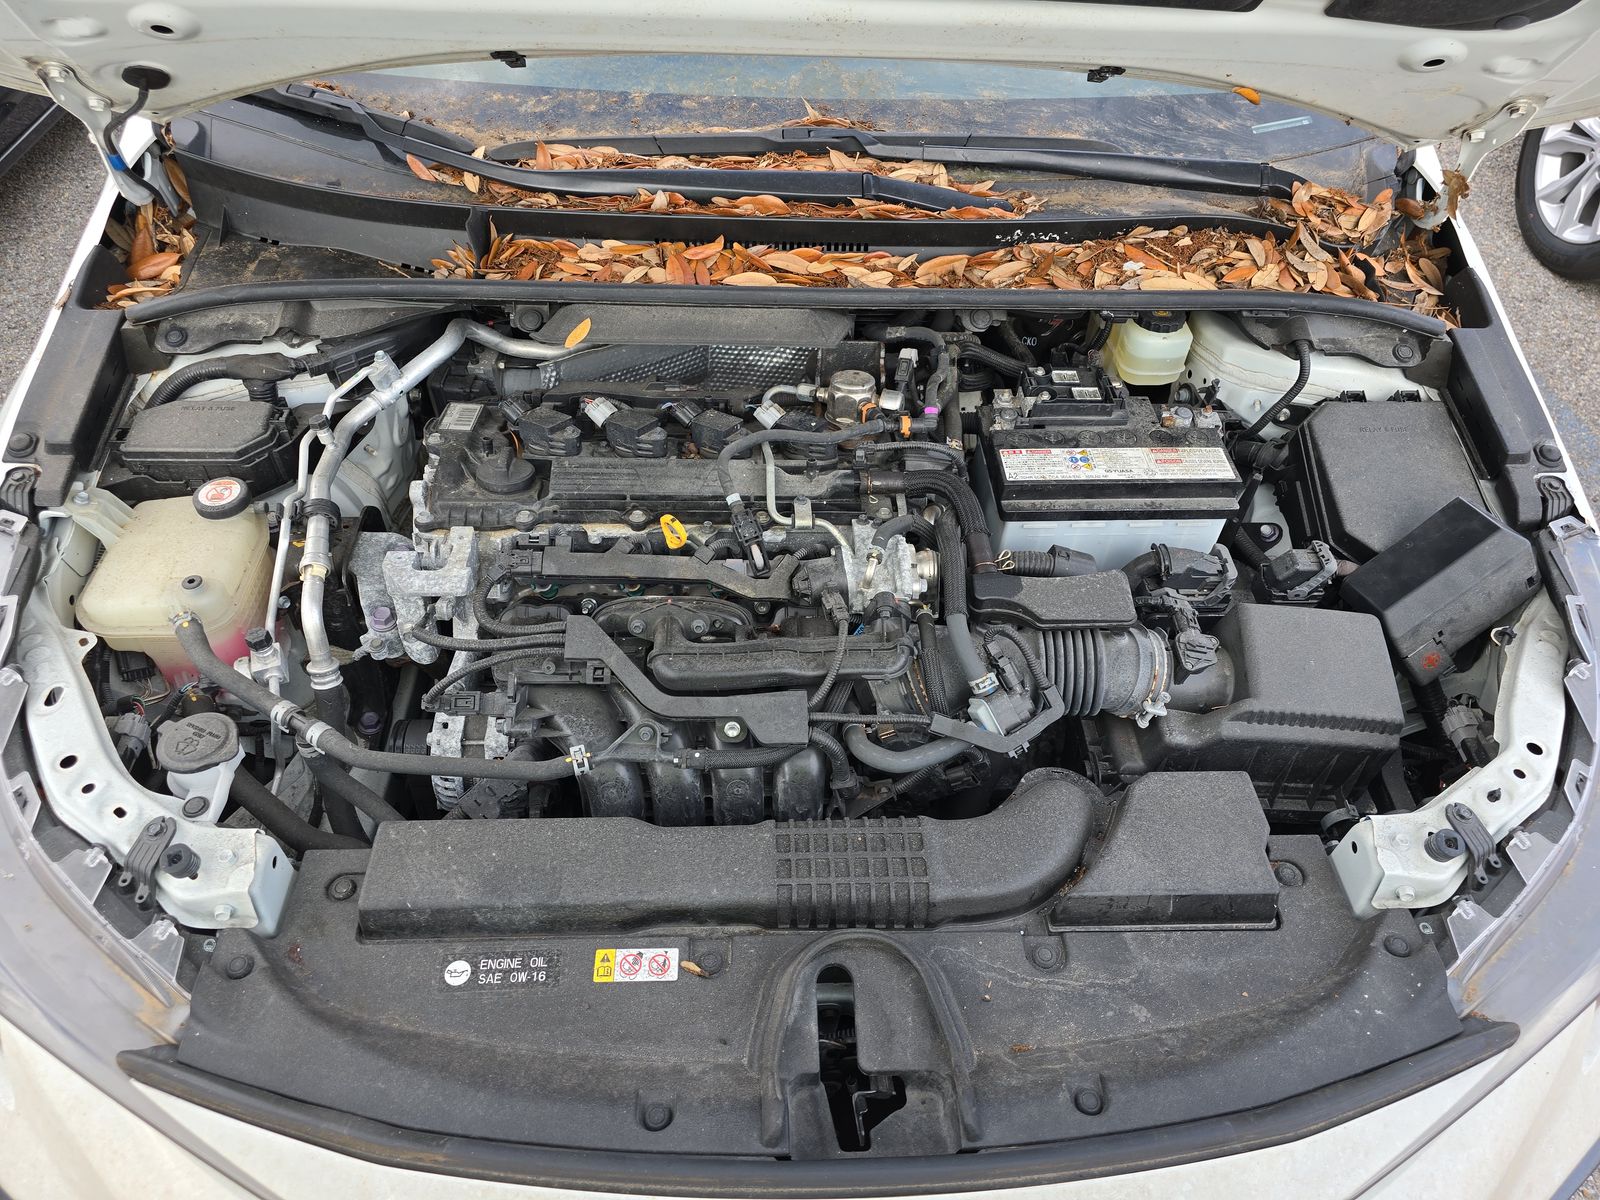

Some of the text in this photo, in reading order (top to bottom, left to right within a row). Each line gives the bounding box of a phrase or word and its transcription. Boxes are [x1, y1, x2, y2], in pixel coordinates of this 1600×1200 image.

[479, 957, 548, 970] ENGINE OIL
[478, 972, 502, 984] SAE
